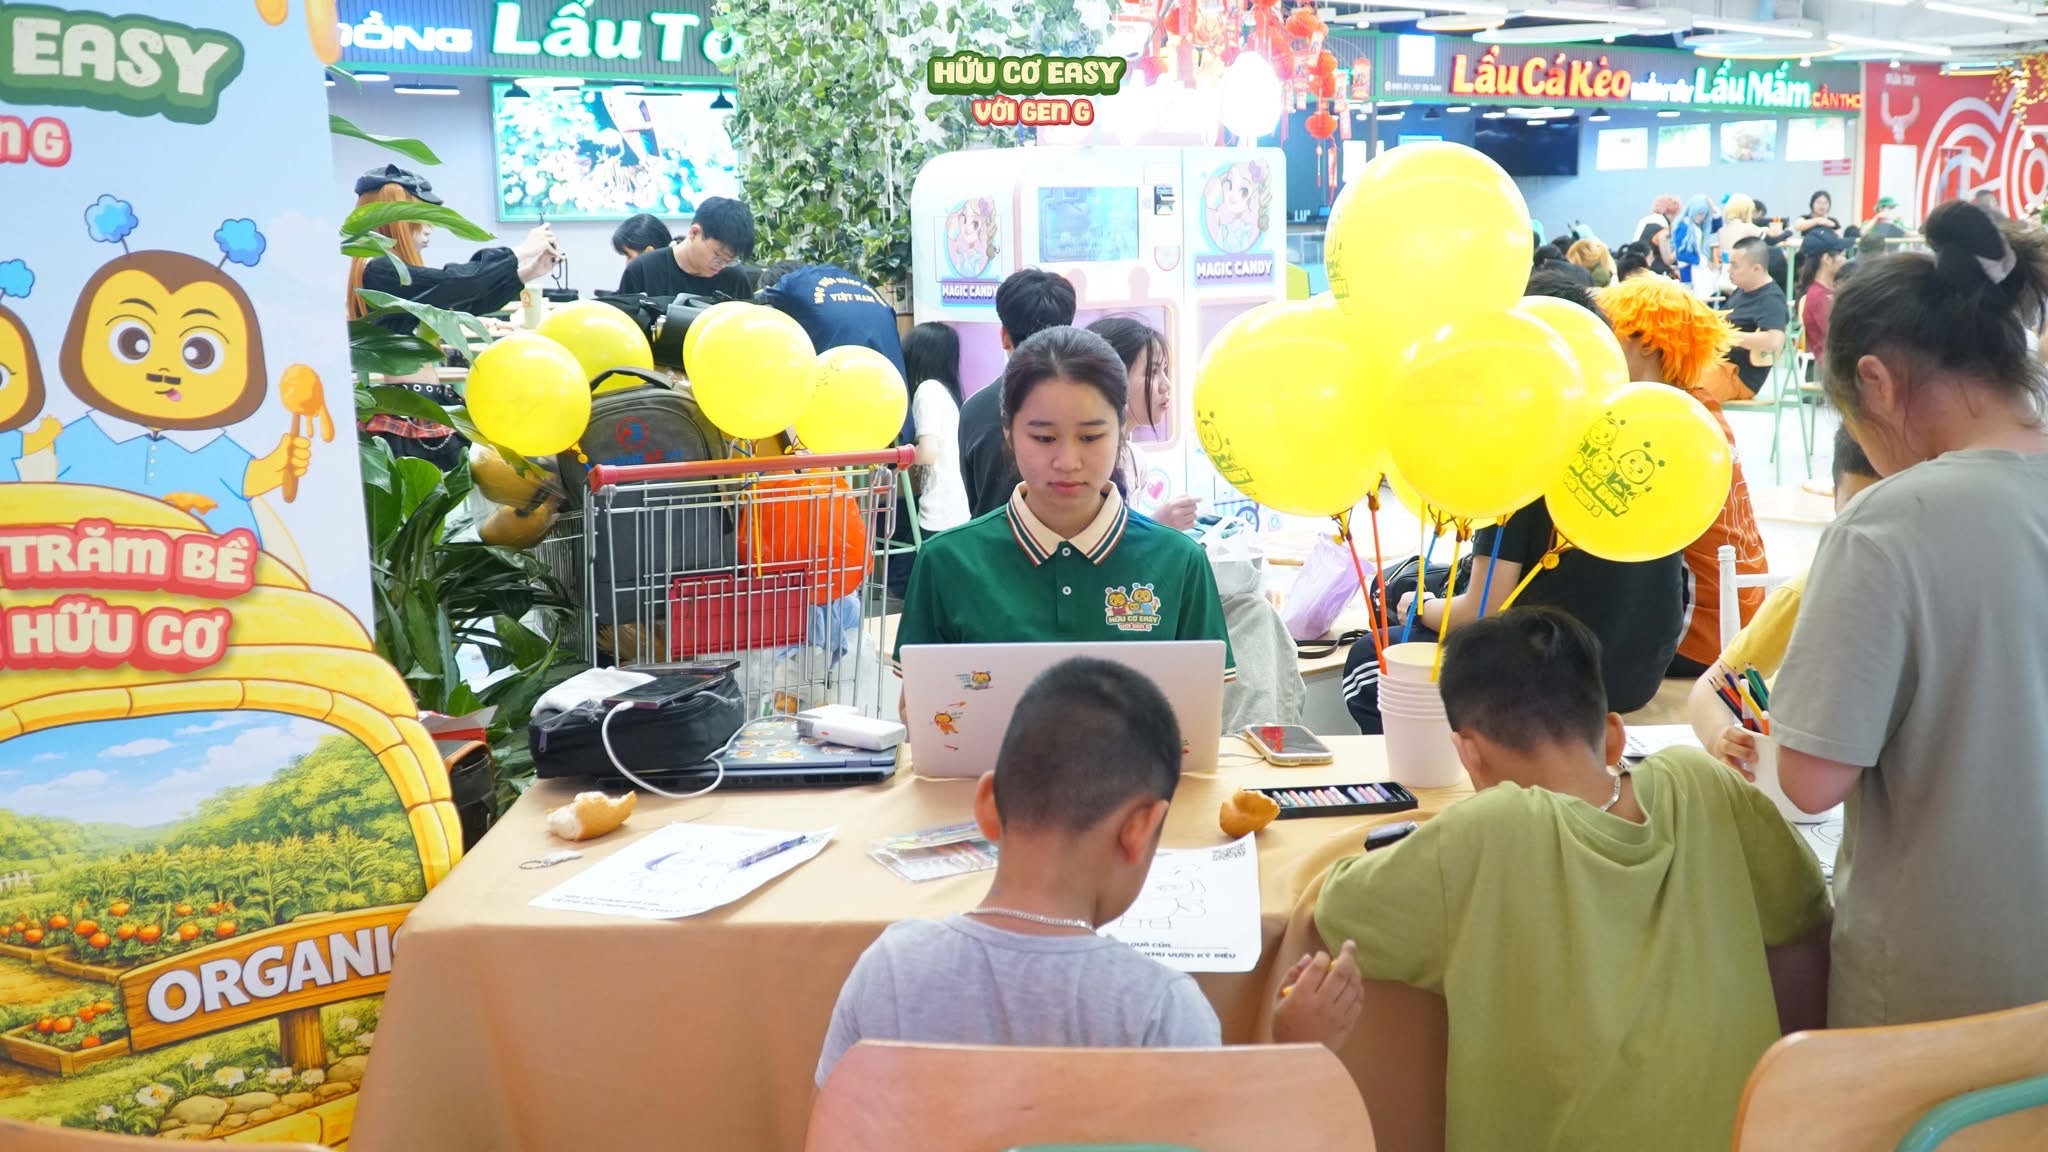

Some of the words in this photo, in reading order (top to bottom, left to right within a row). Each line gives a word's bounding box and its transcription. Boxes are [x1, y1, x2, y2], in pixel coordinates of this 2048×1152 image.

[13, 17, 229, 95] EASY
[1521, 53, 1566, 98] Cá
[1567, 56, 1631, 99] Kèo
[1749, 61, 1812, 108] Mắm
[33, 122, 64, 160] G
[942, 284, 969, 298] MAGIC
[969, 285, 998, 298] CANDY
[1196, 263, 1233, 280] MAGIC
[1233, 258, 1274, 277] CANDY
[0, 527, 167, 575] TRĂM
[181, 537, 249, 584] BỀ
[12, 603, 134, 654] HỮU
[148, 615, 225, 659] CƠ
[147, 924, 401, 1024] ORGANI
